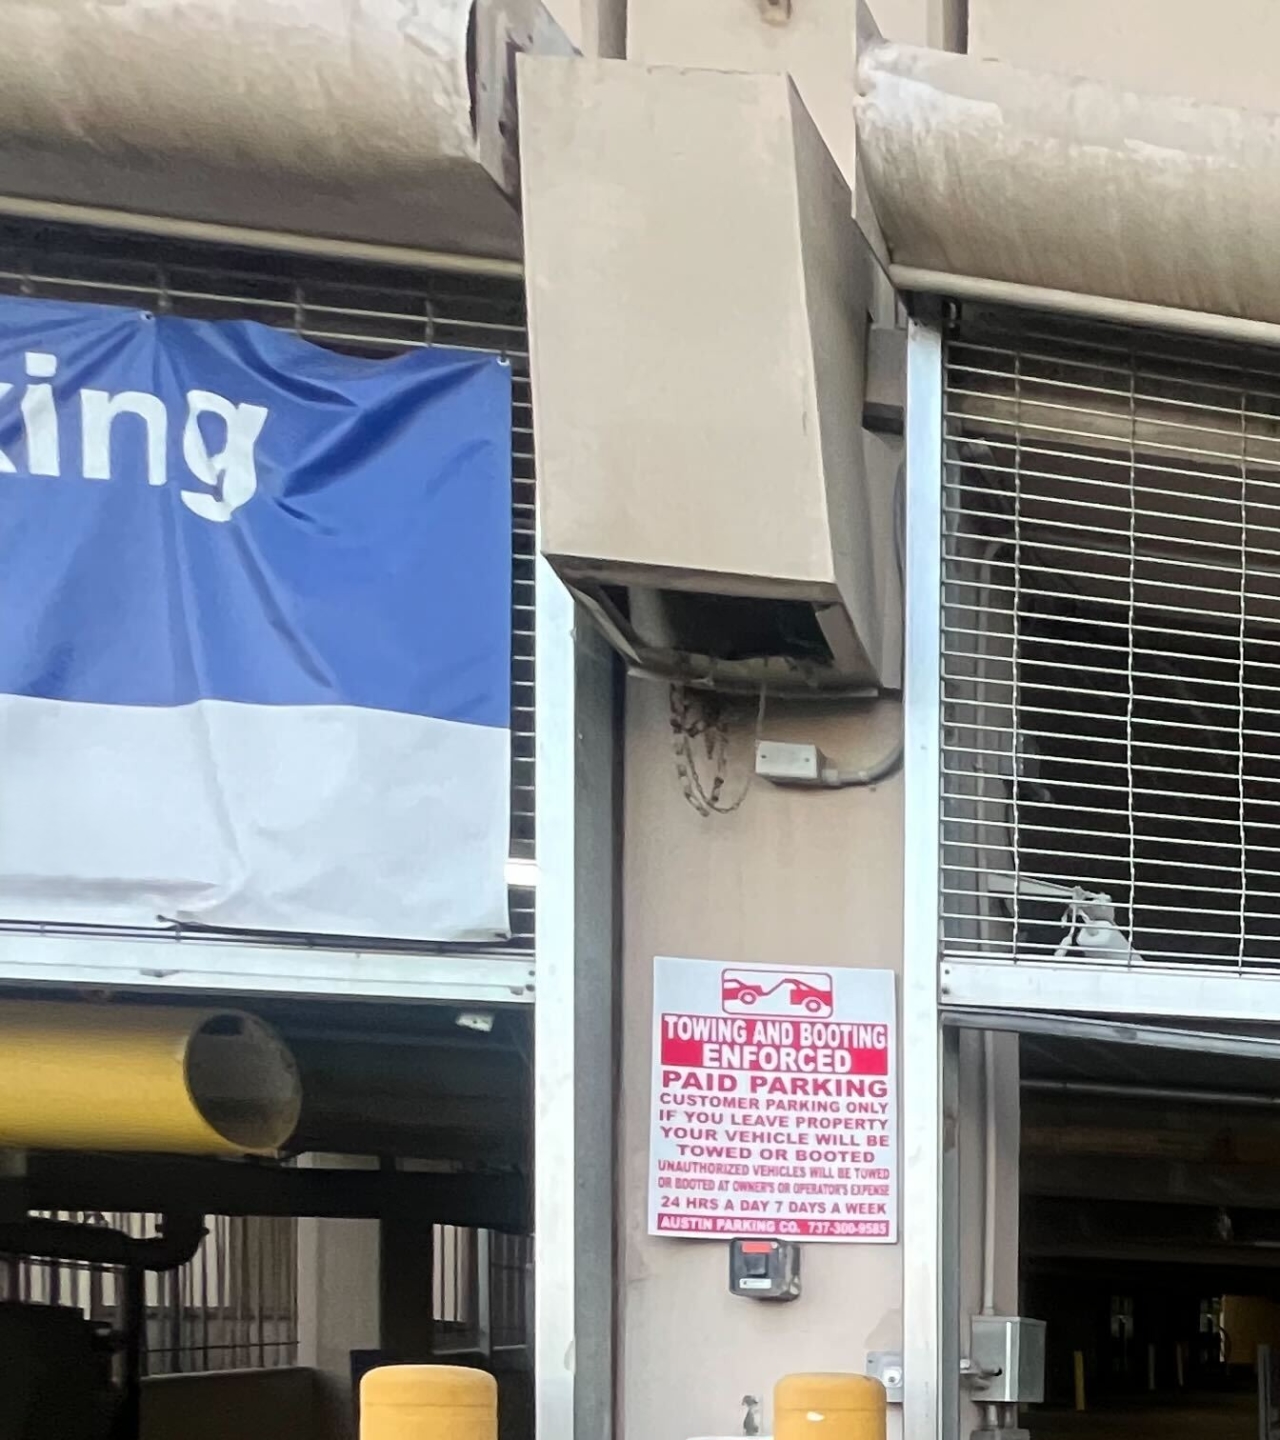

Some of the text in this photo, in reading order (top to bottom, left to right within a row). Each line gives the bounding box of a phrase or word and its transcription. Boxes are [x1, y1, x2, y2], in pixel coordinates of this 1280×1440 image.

[664, 1016, 887, 1049] TOWING AND BOOTING
[703, 1044, 852, 1072] ENFORCED
[662, 1070, 888, 1098] PAID PARKING
[659, 1092, 889, 1115] CUSTOMER PARKING ONLY
[659, 1109, 889, 1131] IF YOU LEAVE PROPERTY
[660, 1126, 890, 1147] YOUR VEHICLE WILL BE
[676, 1144, 875, 1163] TOWED OR BOOTED
[657, 1159, 890, 1180] UNAUTHORIZED VEHICLES WILL BE TOWED
[657, 1176, 672, 1189] OR
[675, 1178, 715, 1191] BOOTED
[718, 1180, 730, 1191] AT
[778, 1182, 790, 1194] OR
[661, 1195, 887, 1215] 24 HRS A DAY 7 DAYS A WEEK
[660, 1216, 713, 1230] AUSTIN
[716, 1218, 776, 1232] PARKING
